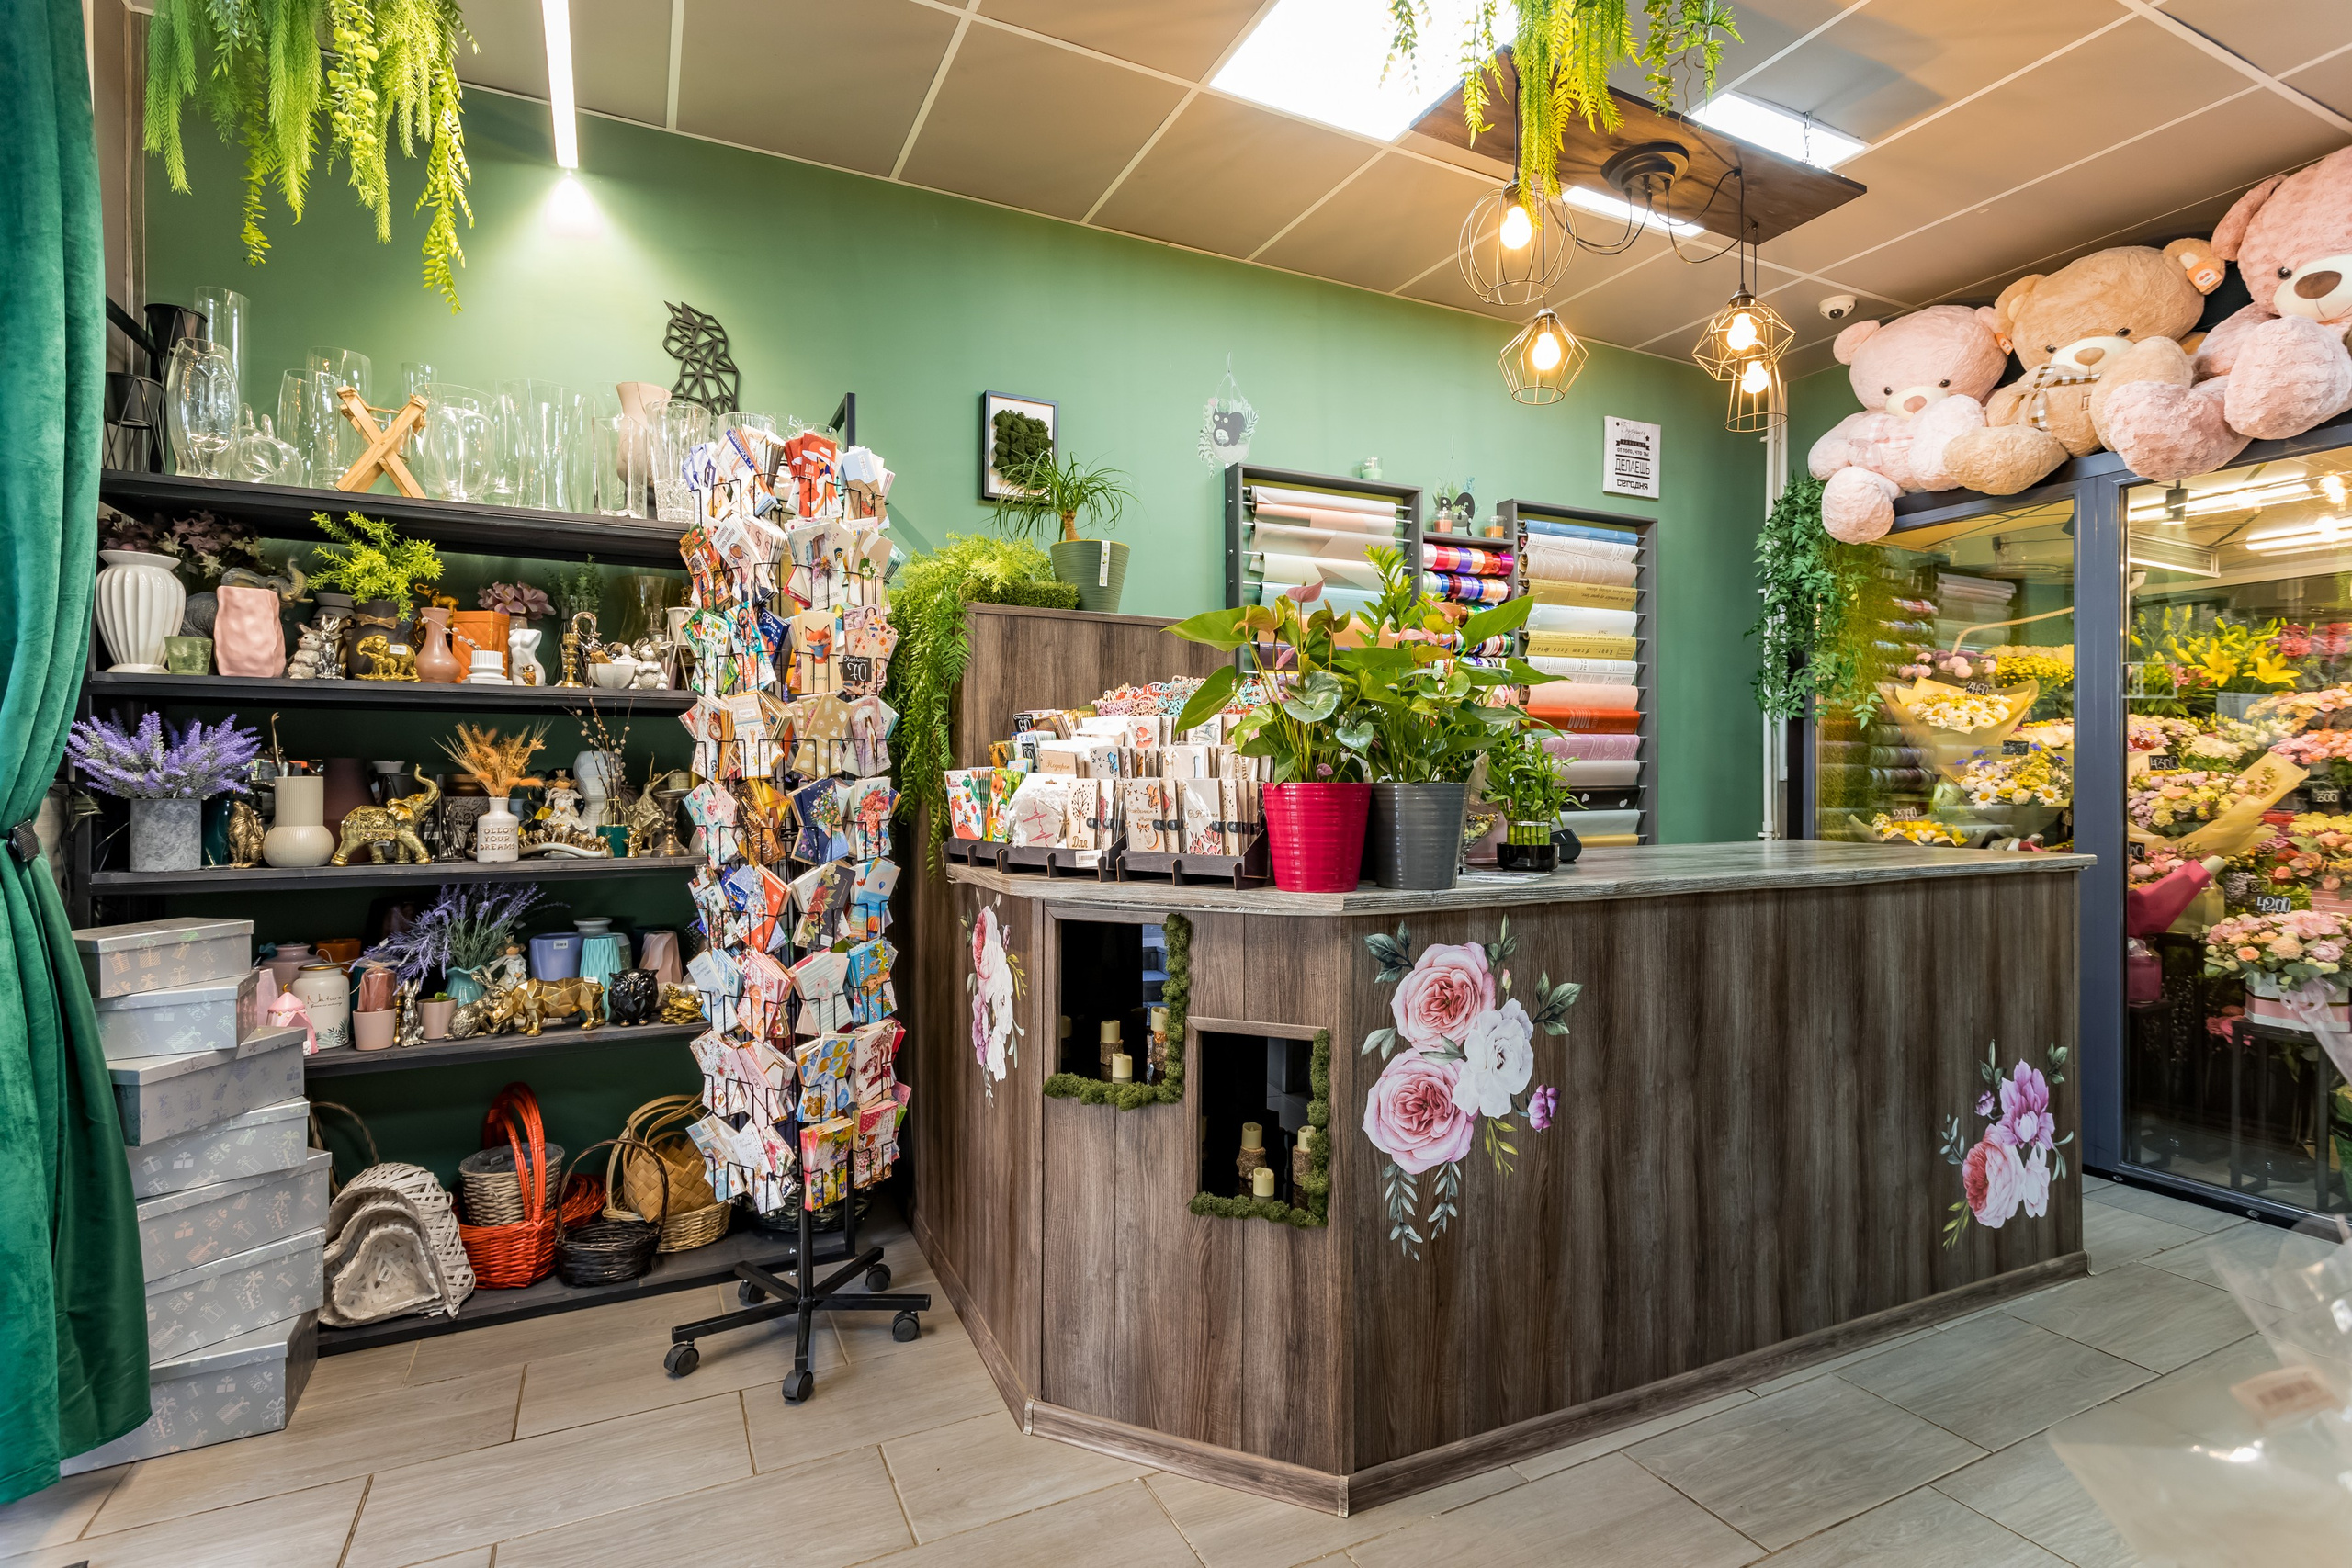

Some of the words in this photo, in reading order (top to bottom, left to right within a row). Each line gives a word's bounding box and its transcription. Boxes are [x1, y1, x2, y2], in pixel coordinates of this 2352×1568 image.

[1615, 458, 1650, 475] ДЕЛАЕШЬ
[847, 662, 867, 681] 70
[2150, 756, 2178, 770] 4300
[480, 827, 515, 835] FOLLOW
[480, 842, 515, 851] DREAMS
[2256, 896, 2291, 913] 4200
[307, 989, 345, 1004] Natural
